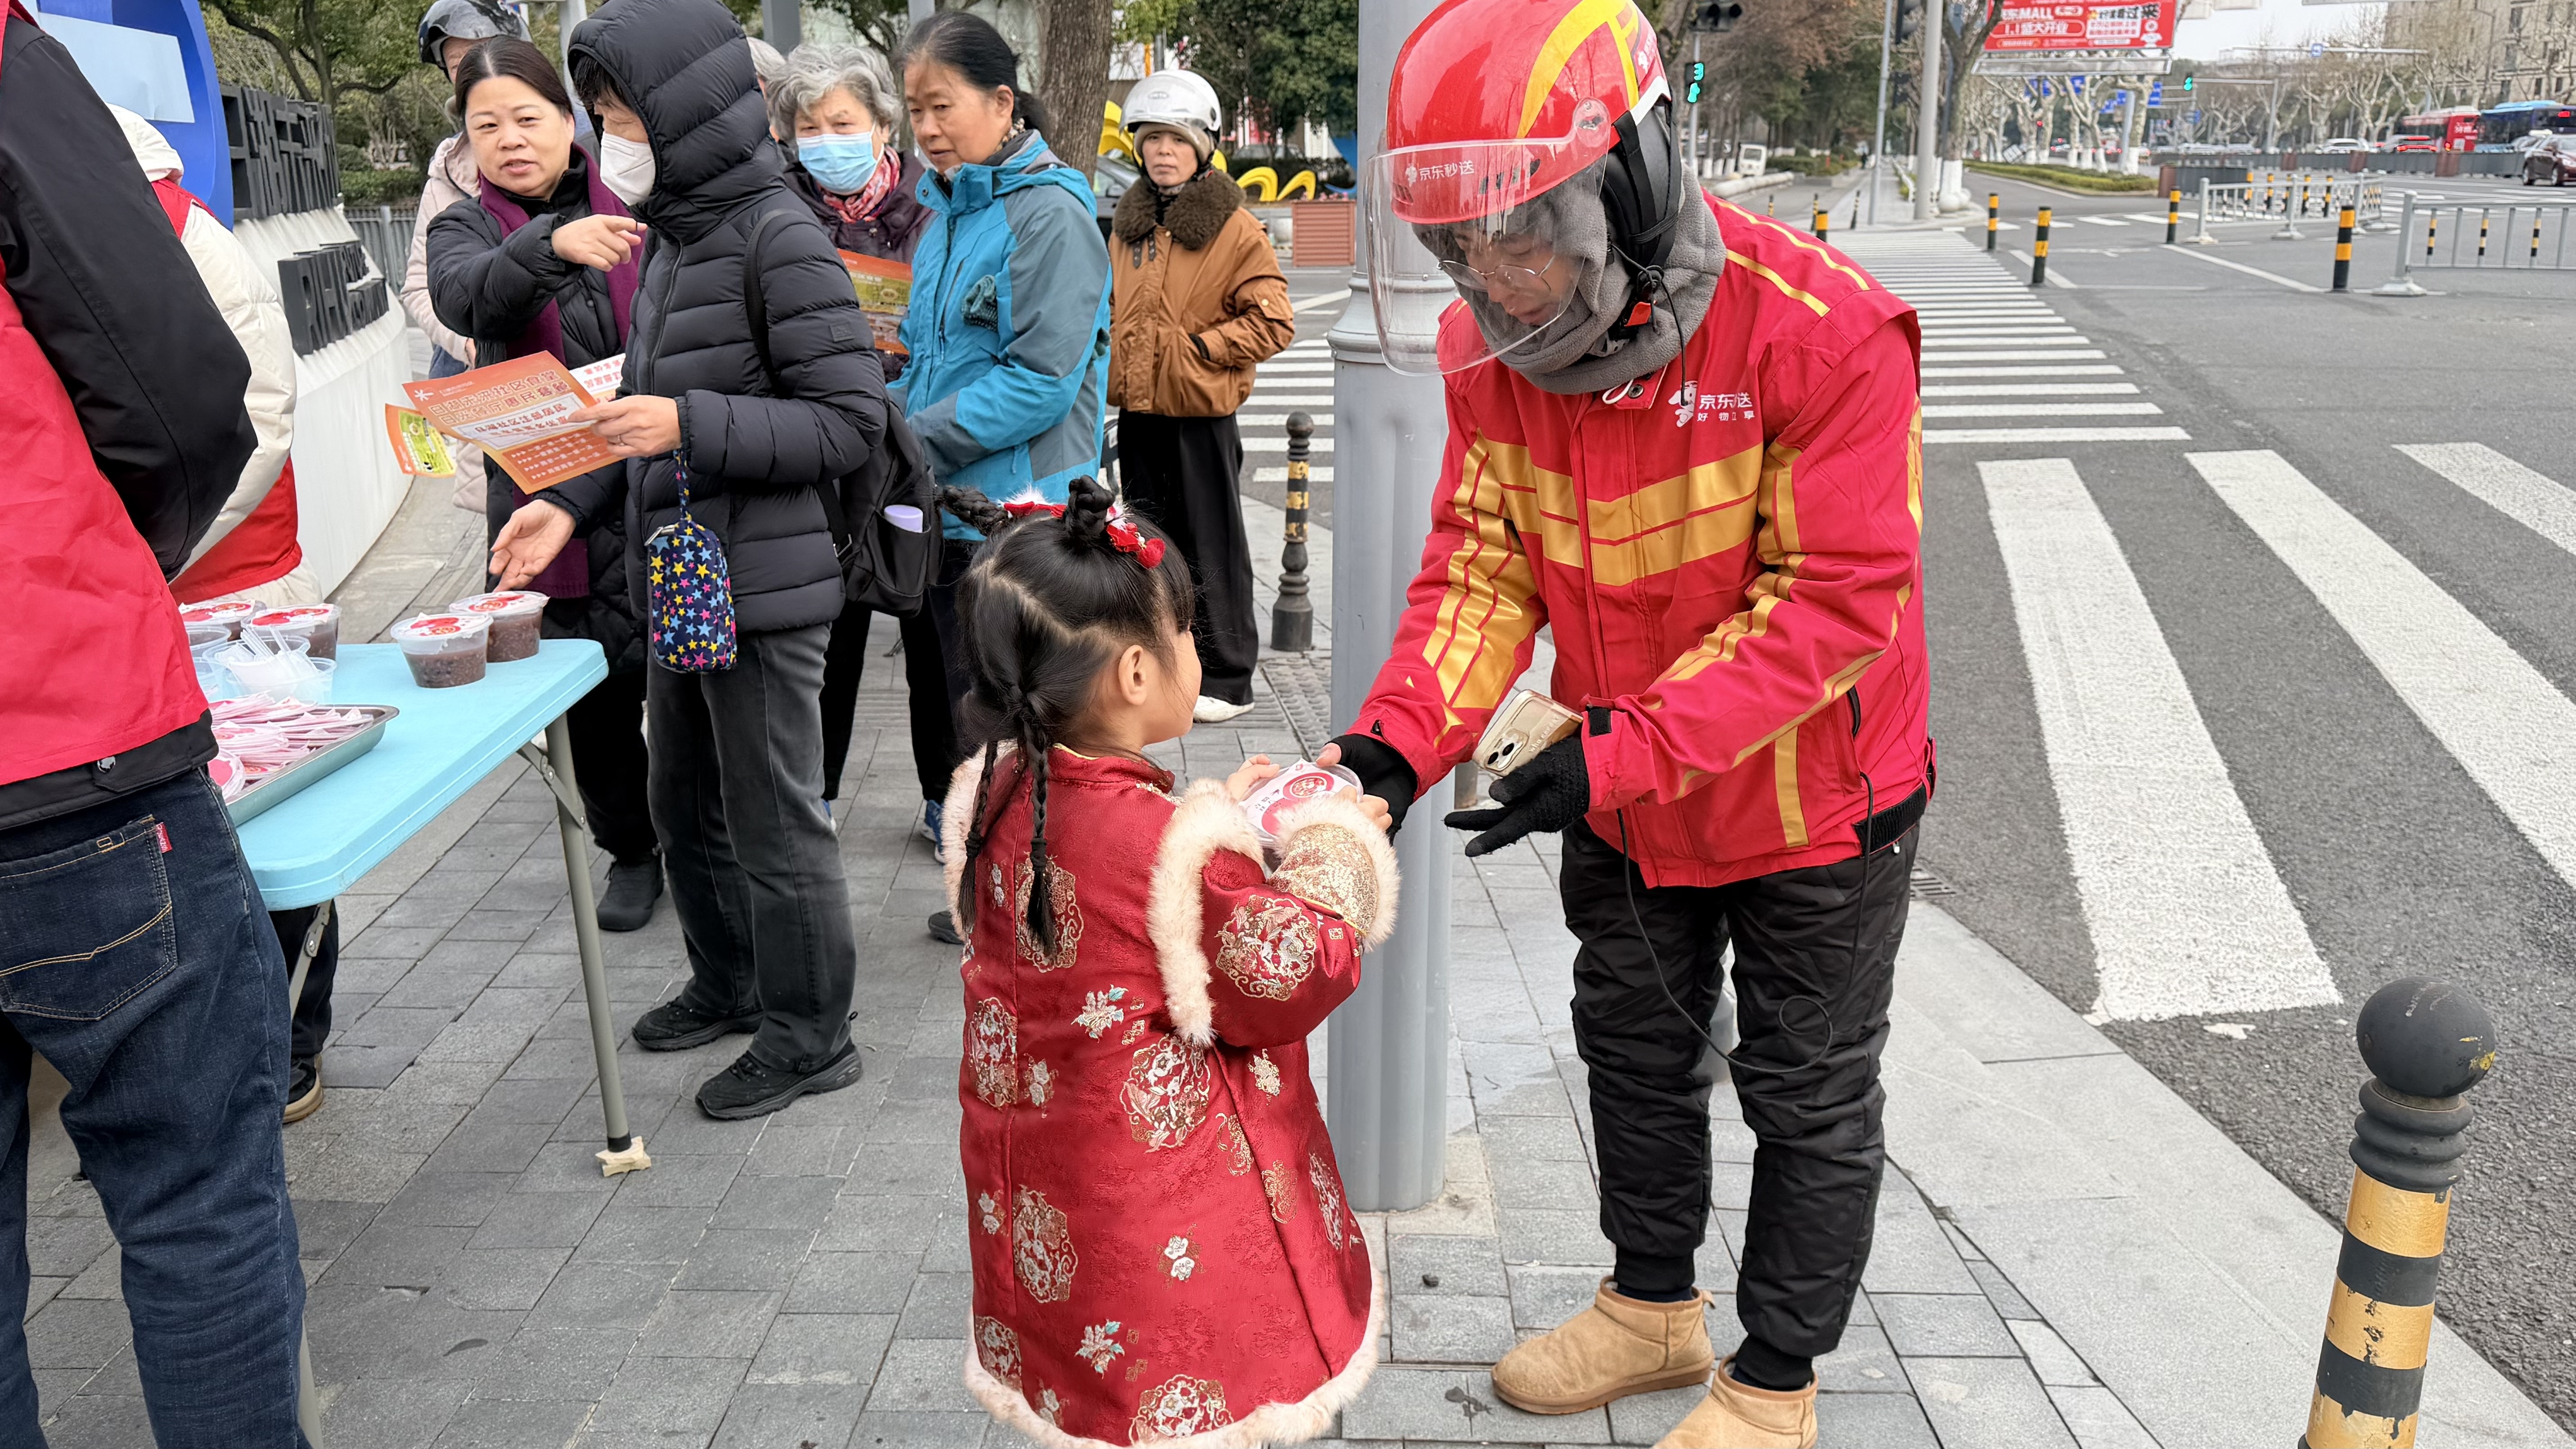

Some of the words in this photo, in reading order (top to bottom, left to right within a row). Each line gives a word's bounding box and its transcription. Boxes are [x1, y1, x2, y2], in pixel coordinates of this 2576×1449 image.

[1419, 160, 1475, 181] 京东秒送
[1699, 392, 1753, 410] 京东送
